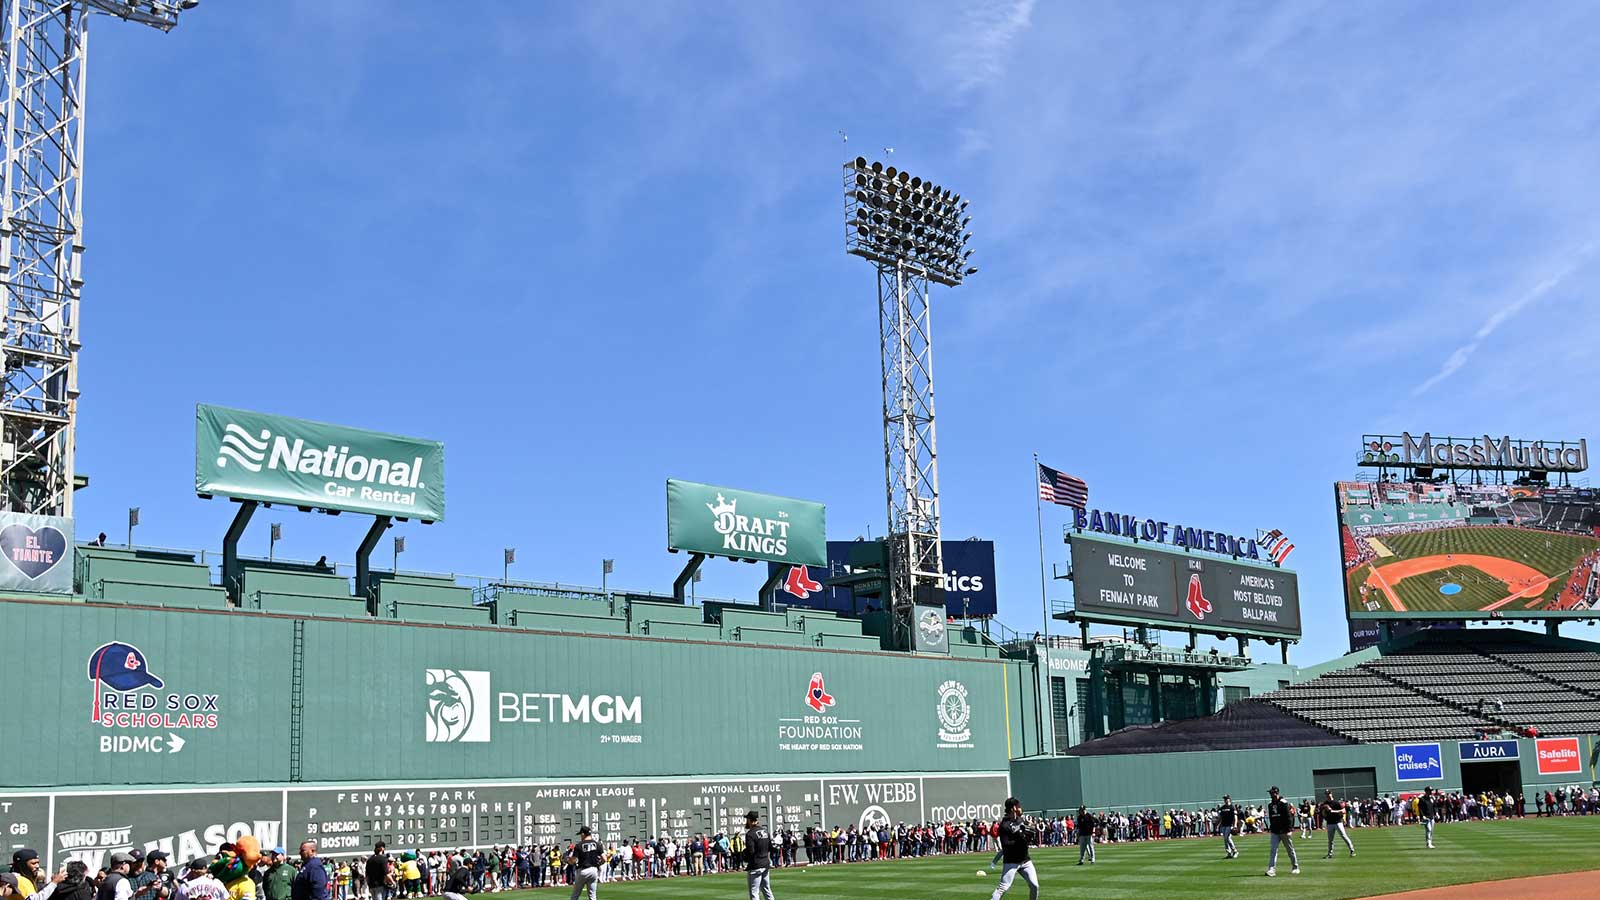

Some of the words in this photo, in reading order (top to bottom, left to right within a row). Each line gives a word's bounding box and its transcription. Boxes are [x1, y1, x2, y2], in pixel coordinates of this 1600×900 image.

[1402, 431, 1588, 470] MassMutual
[324, 482, 355, 499] Car
[361, 487, 416, 505] Rental
[713, 512, 790, 537] DRAFT
[1074, 507, 1137, 538] BANK
[1141, 518, 1169, 543] OF
[1173, 524, 1259, 560] AMERICA
[25, 535, 41, 549] EL
[722, 531, 787, 556] KINGS
[12, 547, 53, 564] TIANTE
[1108, 553, 1147, 571] WELCOME
[1123, 573, 1134, 587] TO
[1240, 575, 1275, 590] AMERICA'S
[1100, 589, 1134, 606] FENWAY
[1137, 594, 1159, 608] PARK
[1233, 590, 1252, 603] MOST
[1253, 593, 1283, 607] BELOVED
[1242, 608, 1277, 622] BALLPARK
[103, 693, 157, 709] RED
[167, 694, 219, 711] SOX
[498, 692, 642, 723] BETMGM
[102, 713, 219, 728] SCHOLARS
[804, 716, 820, 724] RED
[822, 717, 838, 725] SOX
[779, 726, 862, 739] FOUNDATION
[100, 735, 163, 753] BIDMC
[600, 735, 611, 743] 21+
[612, 735, 620, 743] TO
[621, 735, 642, 743] WAGER
[1397, 754, 1413, 763] city
[1539, 749, 1577, 759] Safelite
[1398, 762, 1428, 770] cruises
[536, 788, 591, 798] AMERICAN
[595, 787, 635, 796] LEAGUE
[701, 785, 744, 793] NATIONAL
[748, 784, 781, 792] LEAGUE
[829, 784, 859, 805] F.W.
[864, 782, 917, 804] WEBB
[337, 792, 415, 804] FENWAY
[429, 791, 475, 801] PARK
[661, 798, 667, 807] P
[704, 797, 710, 806] R
[720, 796, 726, 805] P
[760, 795, 766, 804] R
[776, 794, 782, 803] P
[813, 793, 819, 802] R
[525, 801, 532, 811] P
[562, 800, 572, 810] IN
[575, 800, 582, 809] R
[592, 799, 598, 809] P
[628, 798, 636, 808] IN
[640, 798, 646, 807] R
[309, 808, 317, 819] P
[365, 805, 370, 817] 1
[374, 805, 381, 817] 2
[384, 805, 392, 816] 3
[397, 804, 406, 816] 4
[407, 804, 415, 816] 5
[417, 803, 425, 815] 6
[430, 804, 438, 814] 7
[440, 803, 448, 814] 8
[449, 803, 457, 814] 9
[461, 803, 472, 814] 10
[481, 803, 488, 813] R
[494, 802, 502, 812] H
[507, 802, 514, 811] E
[676, 810, 685, 818] SF
[734, 808, 744, 816] SD
[786, 805, 801, 814] WSH
[931, 801, 1002, 821] moderna
[539, 814, 556, 824] SEA
[605, 812, 621, 821] LAD
[732, 817, 747, 825] HOU
[787, 814, 800, 823] COL
[10, 823, 28, 835] GB
[307, 823, 318, 834] 59
[321, 821, 360, 833] CHICAGO
[539, 825, 556, 834] TOR
[606, 822, 621, 831] TEX
[674, 820, 688, 828] LAA
[790, 823, 800, 832] AZ
[59, 831, 97, 848] WHO
[101, 829, 131, 846] BUT
[606, 832, 621, 841] ATH
[674, 830, 688, 838] CLE
[321, 836, 360, 848] BOSTON
[540, 836, 556, 845] NYY
